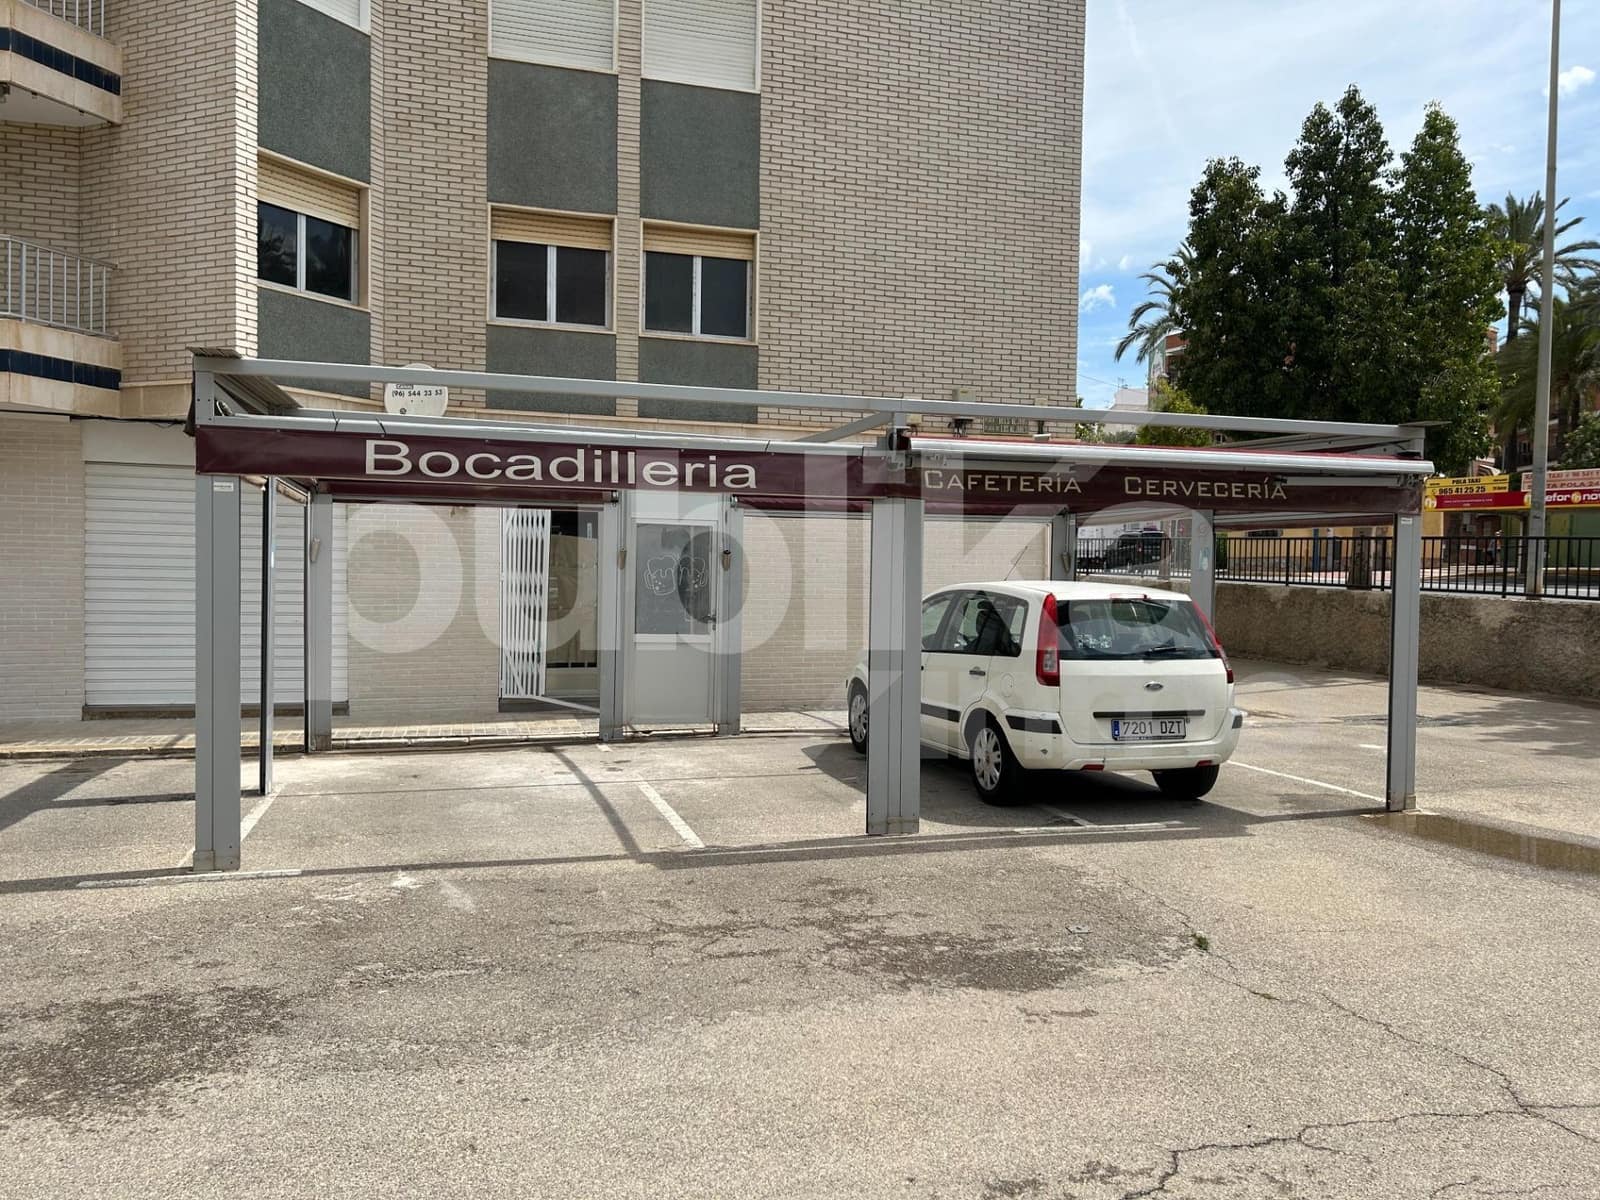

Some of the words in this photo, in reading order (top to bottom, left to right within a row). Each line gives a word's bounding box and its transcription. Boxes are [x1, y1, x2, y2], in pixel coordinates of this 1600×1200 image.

[365, 439, 758, 490] Bocadilleria
[1438, 487, 1453, 495] 965
[1464, 486, 1474, 494] 25
[1475, 485, 1486, 493] 25
[1123, 721, 1153, 735] 7201
[1160, 720, 1182, 734] DZT
